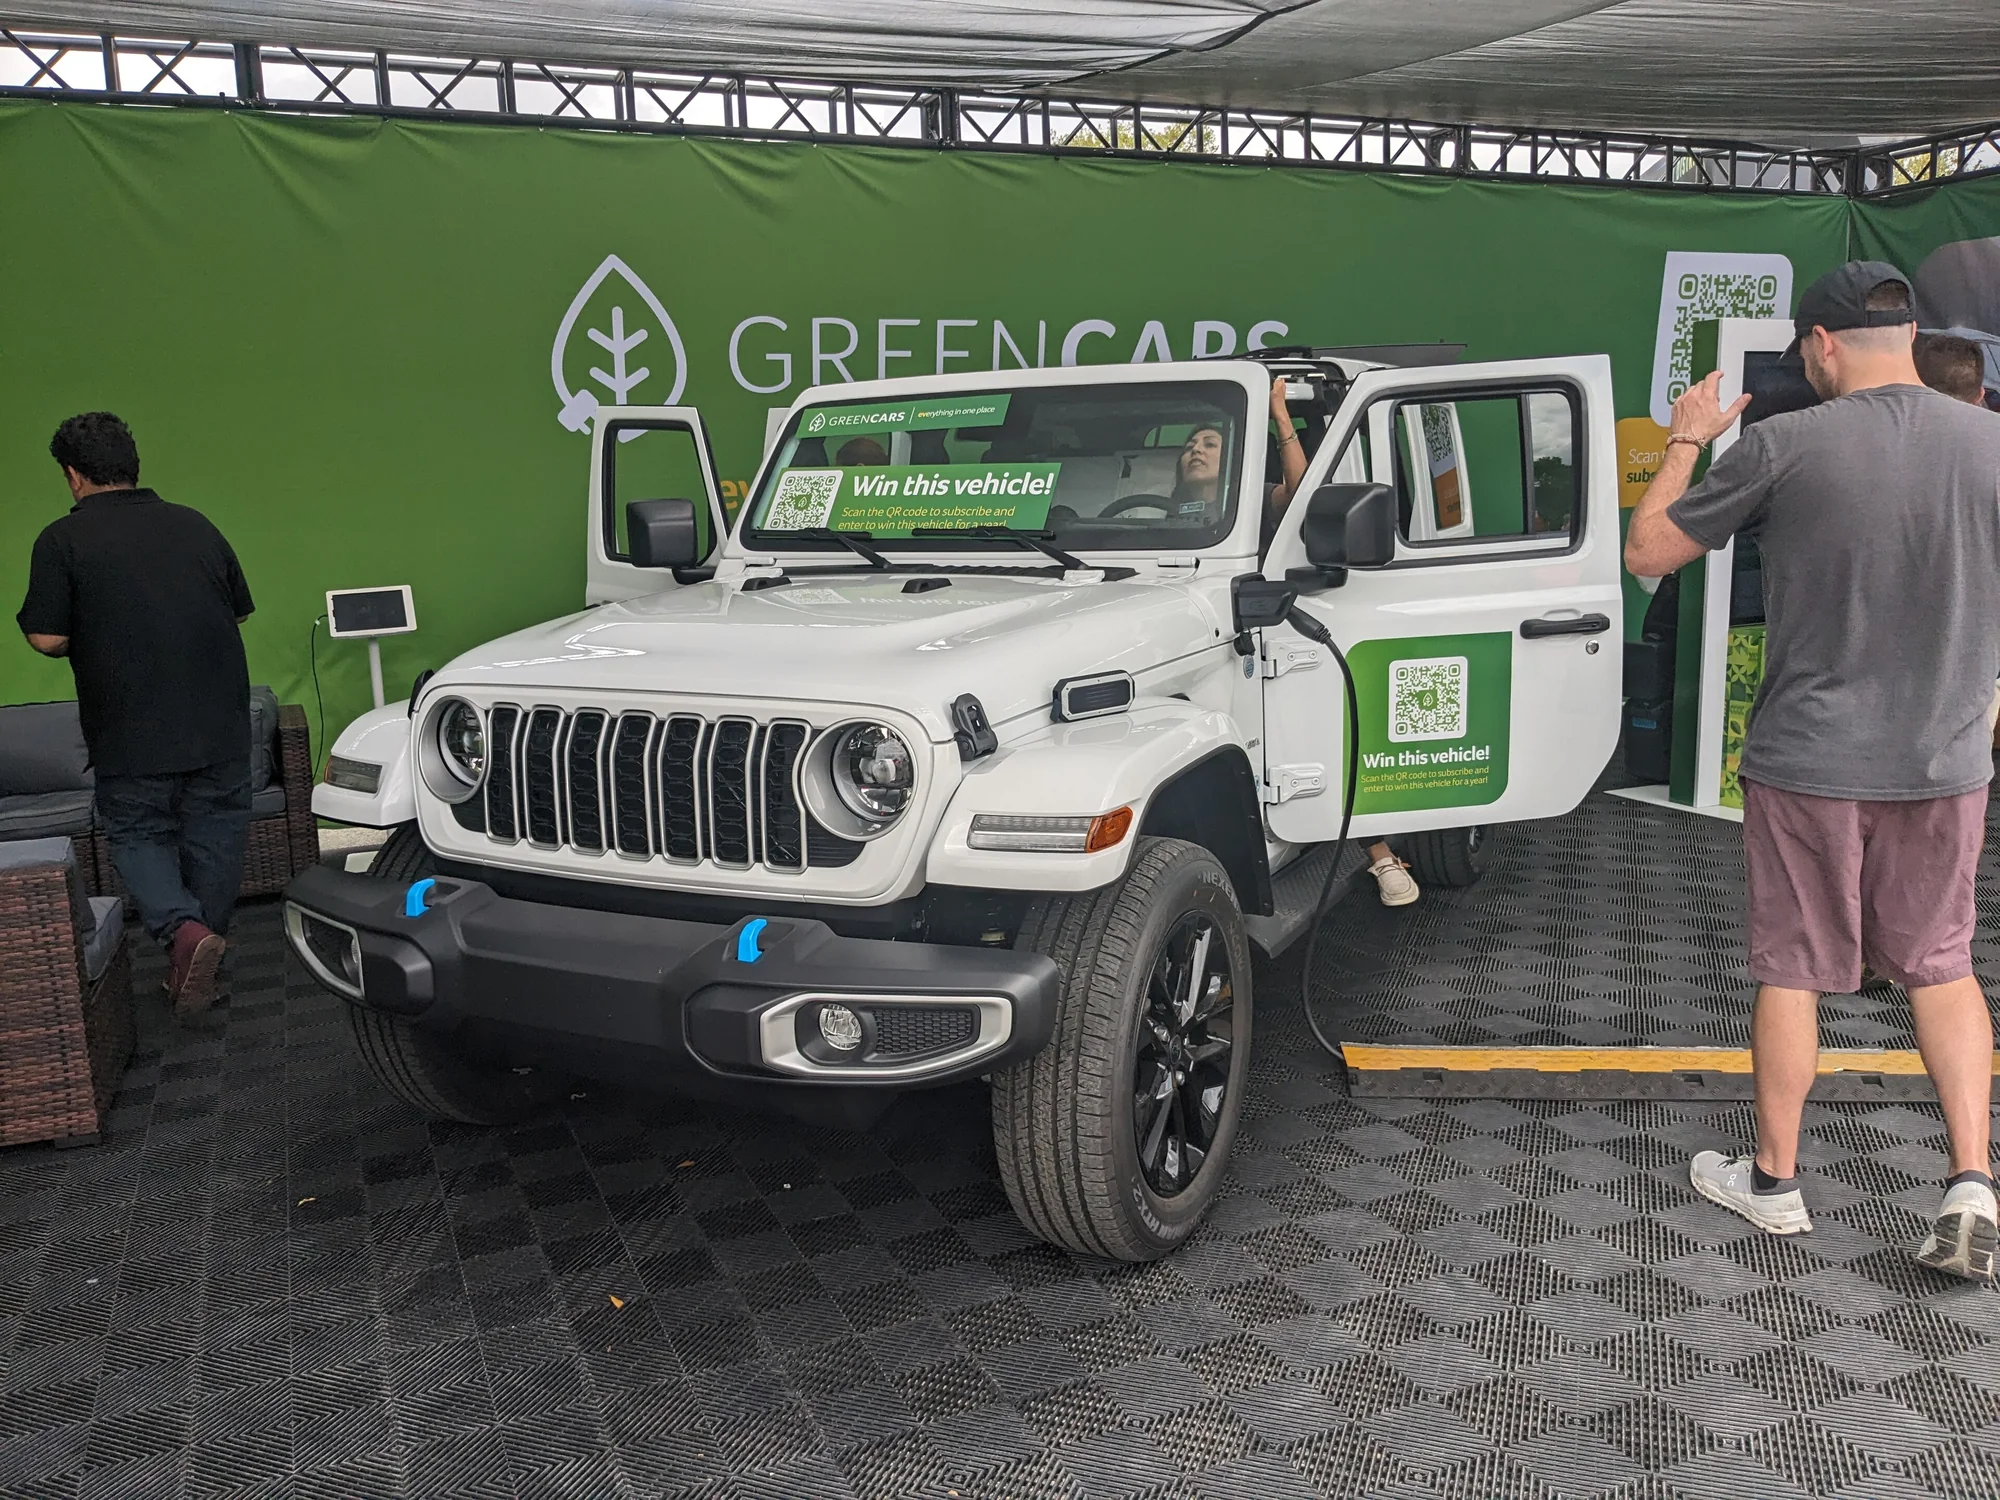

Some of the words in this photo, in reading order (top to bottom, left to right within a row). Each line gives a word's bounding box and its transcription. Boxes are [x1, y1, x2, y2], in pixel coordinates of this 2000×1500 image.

[828, 411, 905, 426] GREENCARS
[917, 408, 954, 417] everything
[954, 408, 961, 416] in
[962, 407, 976, 415] one
[976, 405, 995, 416] place
[1628, 448, 1659, 464] Scan
[853, 473, 899, 497] Win
[903, 472, 950, 497] this
[954, 471, 1055, 496] vehicle!
[841, 506, 866, 517] Scan
[867, 506, 884, 517] the
[886, 506, 902, 518] QR
[902, 505, 928, 517] code
[929, 507, 941, 516] to
[941, 506, 992, 516] subscribe
[993, 506, 1016, 516] and
[838, 520, 865, 530] enter
[865, 521, 876, 530] to
[877, 520, 896, 530] win
[897, 519, 916, 530] this
[917, 519, 954, 529] vehicle
[954, 518, 971, 529] for
[1363, 752, 1395, 769] Win
[1398, 749, 1428, 767] this
[1430, 745, 1490, 765] vehicle!
[1360, 774, 1380, 783] Scan
[1381, 773, 1394, 781] the
[1395, 772, 1408, 781] QR
[1408, 771, 1428, 780] code
[1428, 770, 1437, 778] to
[1438, 767, 1474, 777] subscribe
[1474, 766, 1490, 774] and
[1363, 784, 1384, 793] enter
[1385, 784, 1394, 792] to
[1395, 782, 1409, 791] win
[1409, 781, 1424, 790] this
[1424, 778, 1451, 788] vehicle
[1452, 776, 1463, 786] for
[1469, 775, 1488, 787] year!
